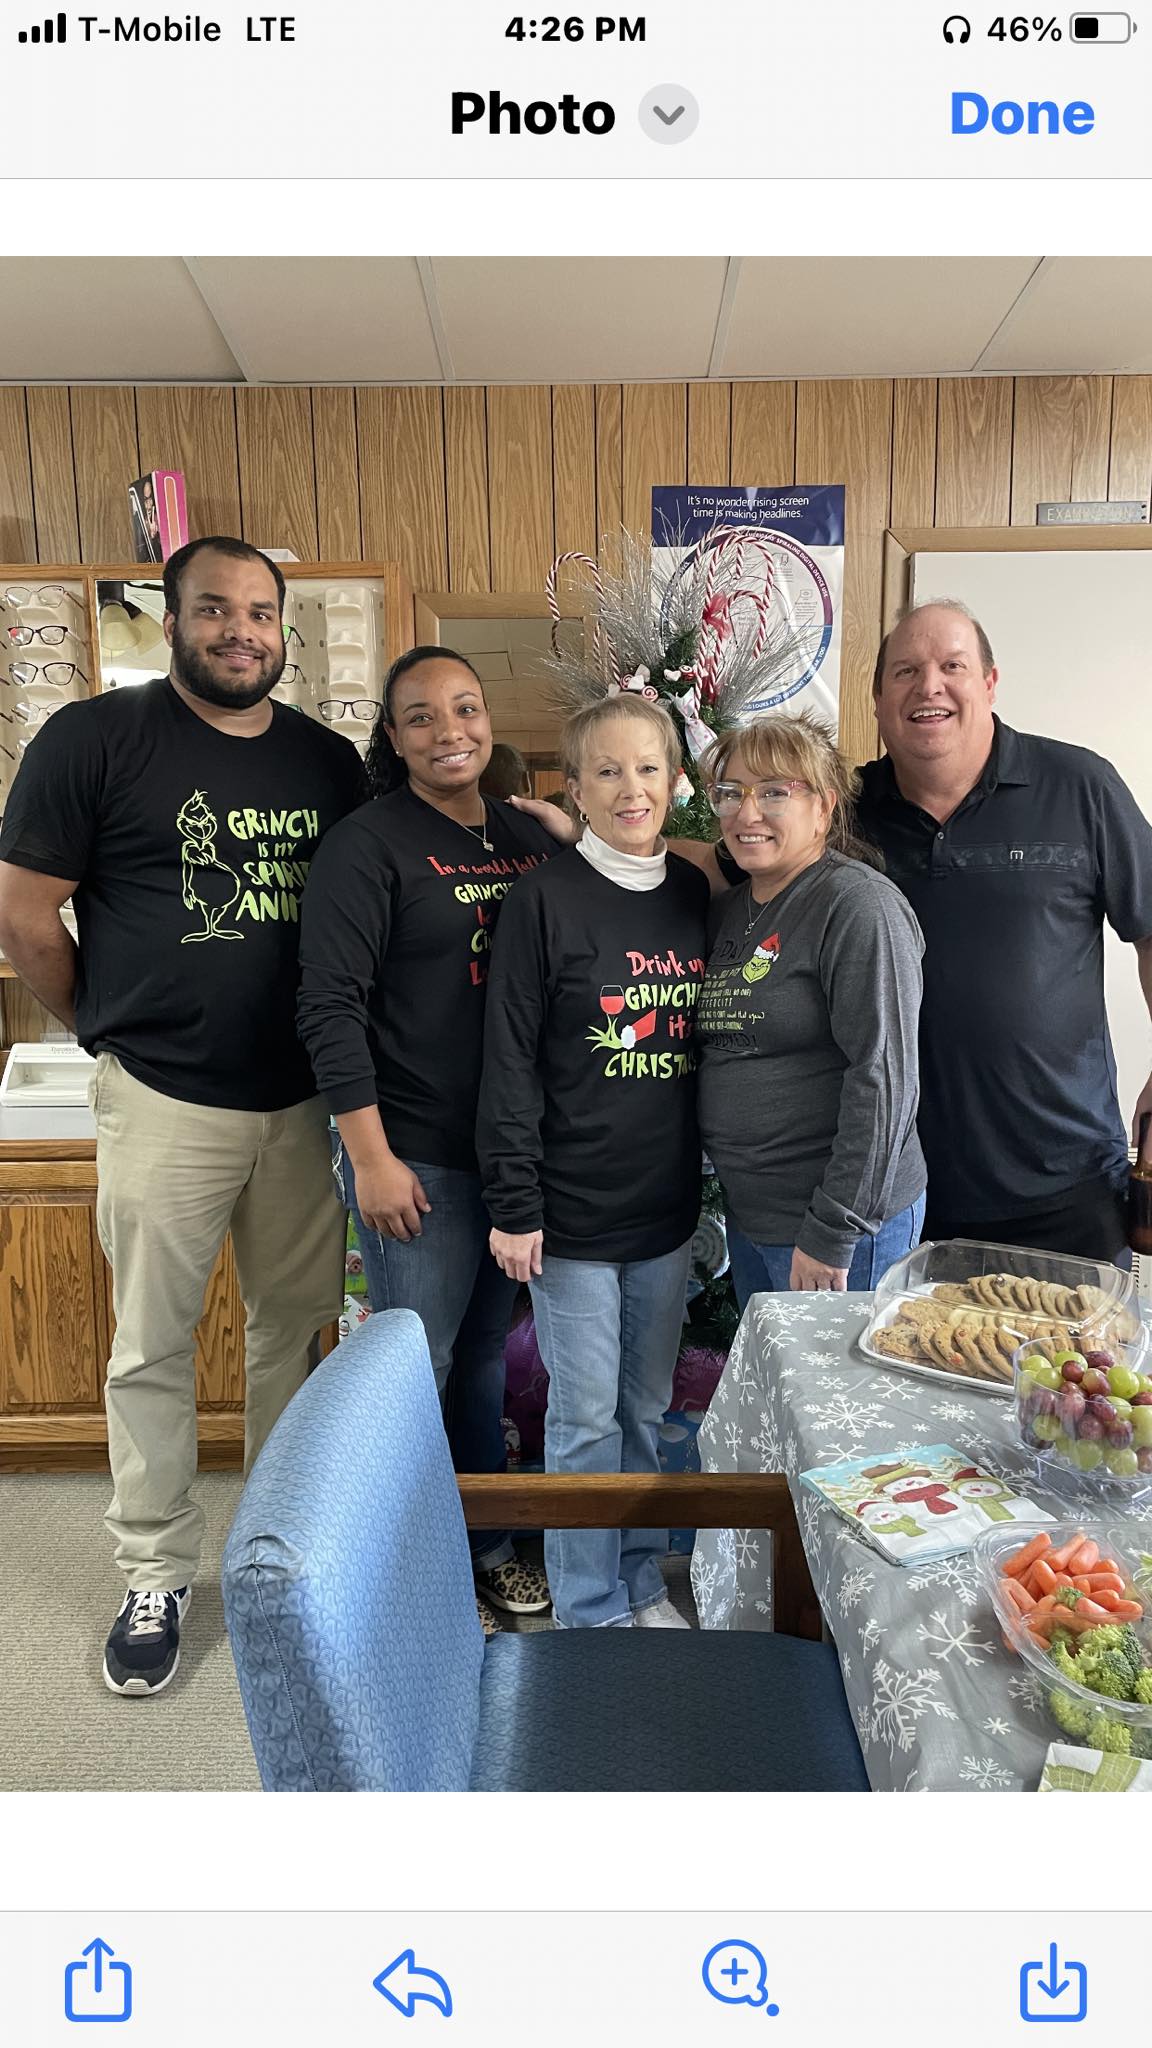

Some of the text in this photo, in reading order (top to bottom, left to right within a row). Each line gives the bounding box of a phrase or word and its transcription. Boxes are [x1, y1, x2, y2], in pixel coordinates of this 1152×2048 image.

[687, 495, 809, 509] It's no wonder rising screen
[693, 508, 714, 518] time
[715, 508, 723, 518] is
[724, 508, 757, 521] making
[776, 537, 801, 556] SPIRALING
[799, 552, 814, 570] DIGITAL
[812, 568, 825, 587] DEVICE
[257, 842, 297, 858] IS MY
[625, 950, 686, 978] Drink
